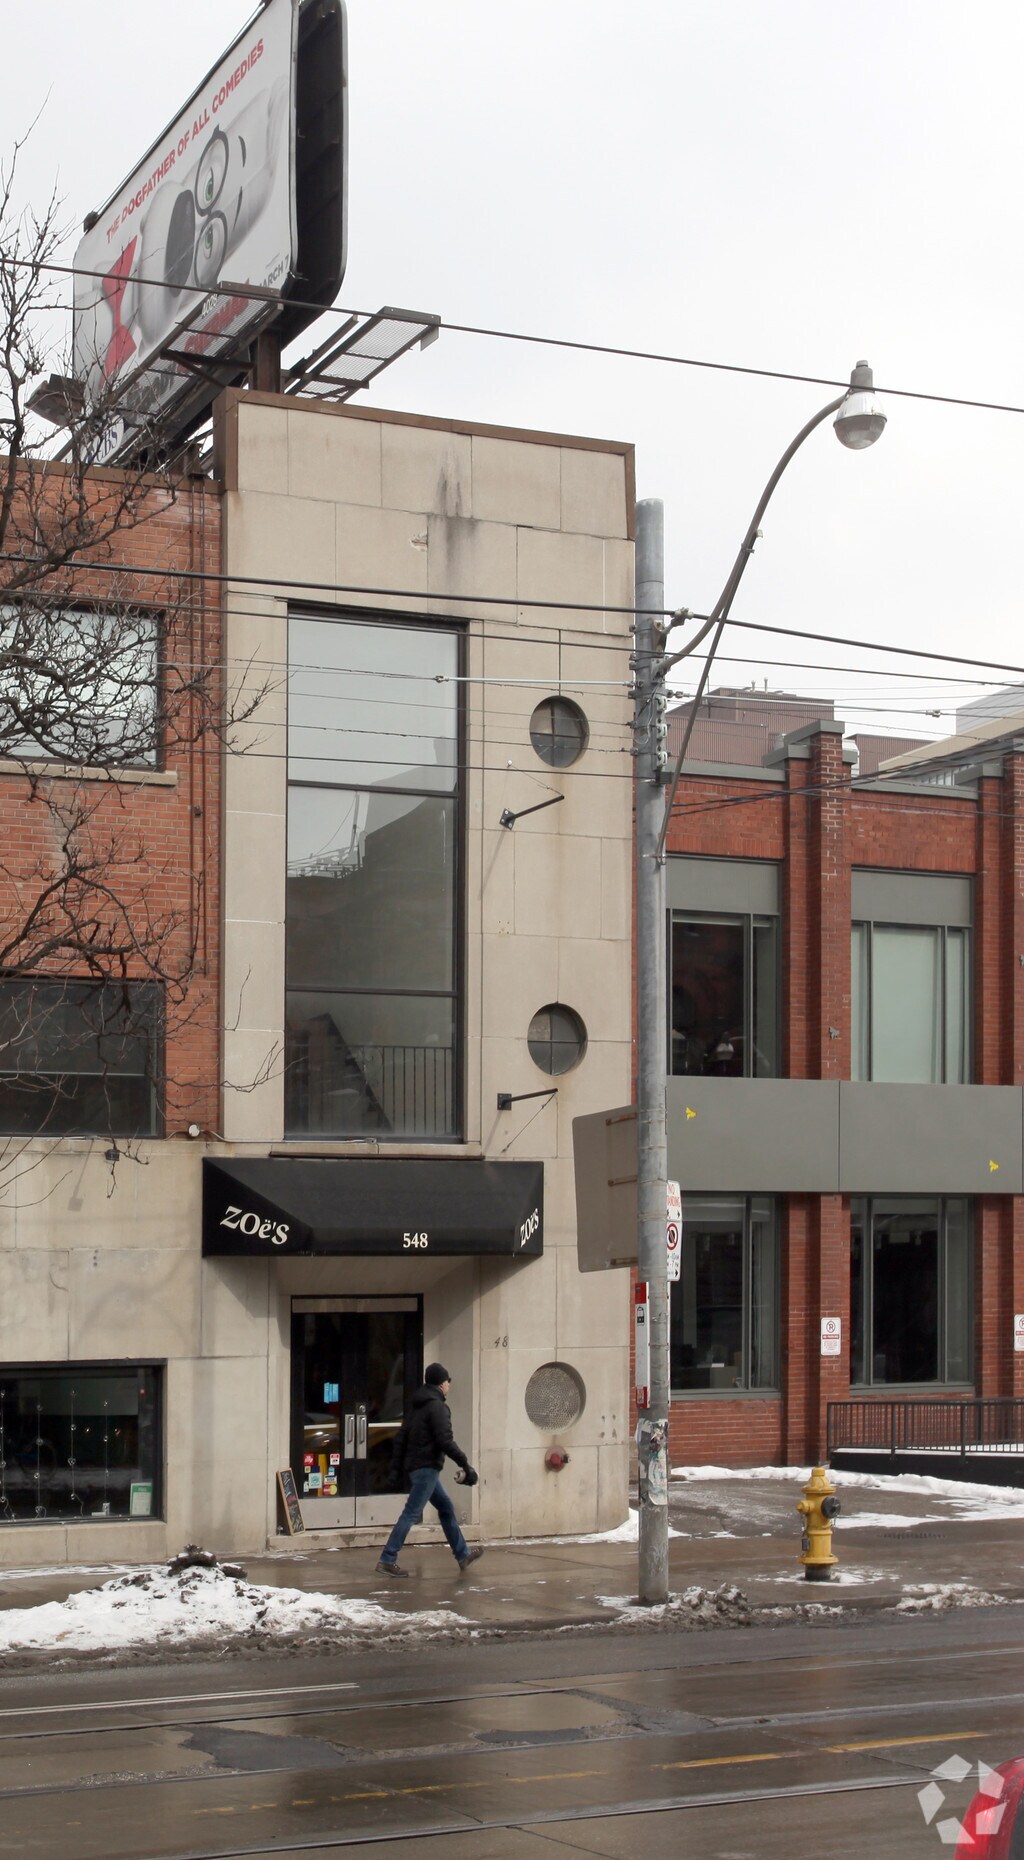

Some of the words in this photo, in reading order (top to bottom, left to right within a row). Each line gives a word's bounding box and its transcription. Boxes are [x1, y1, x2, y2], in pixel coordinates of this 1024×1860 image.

[106, 214, 121, 244] THE
[120, 149, 176, 224] DOGFATHER
[177, 129, 190, 157] OF
[191, 108, 210, 141] ALL
[212, 38, 264, 114] COMEDIES
[284, 252, 290, 270] 7
[402, 1232, 429, 1248] 548
[494, 1335, 509, 1348] 48
